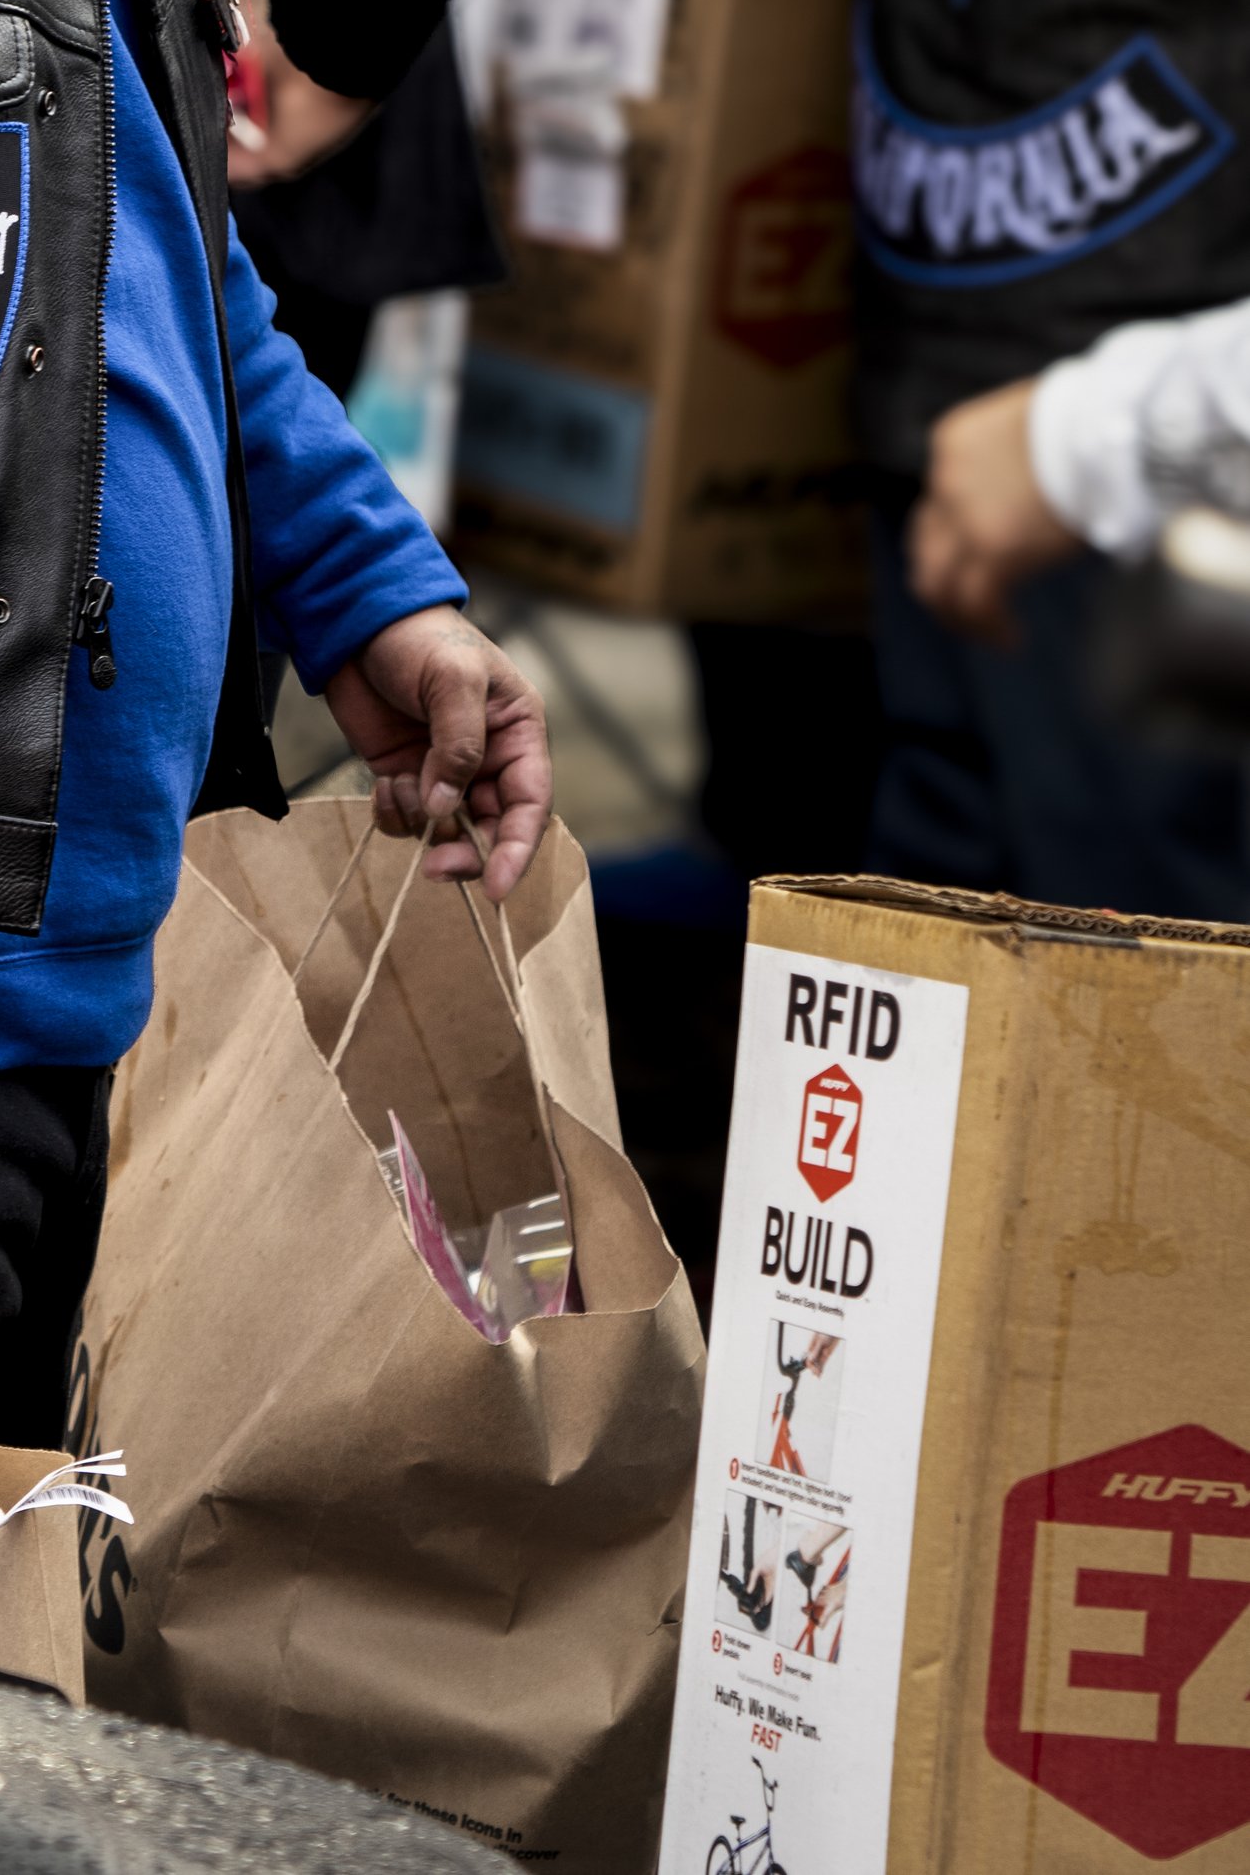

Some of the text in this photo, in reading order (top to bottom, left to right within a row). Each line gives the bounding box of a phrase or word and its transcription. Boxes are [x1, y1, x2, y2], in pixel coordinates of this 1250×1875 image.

[784, 972, 902, 1063] RFID
[818, 1077, 851, 1093] HUFFY
[800, 1092, 860, 1174] EZ
[760, 1205, 874, 1300] BUILD
[751, 1723, 782, 1753] FAST
[766, 1704, 793, 1732] Make
[413, 1800, 458, 1826] these
[461, 1814, 503, 1839] icons
[506, 1827, 523, 1845] in
